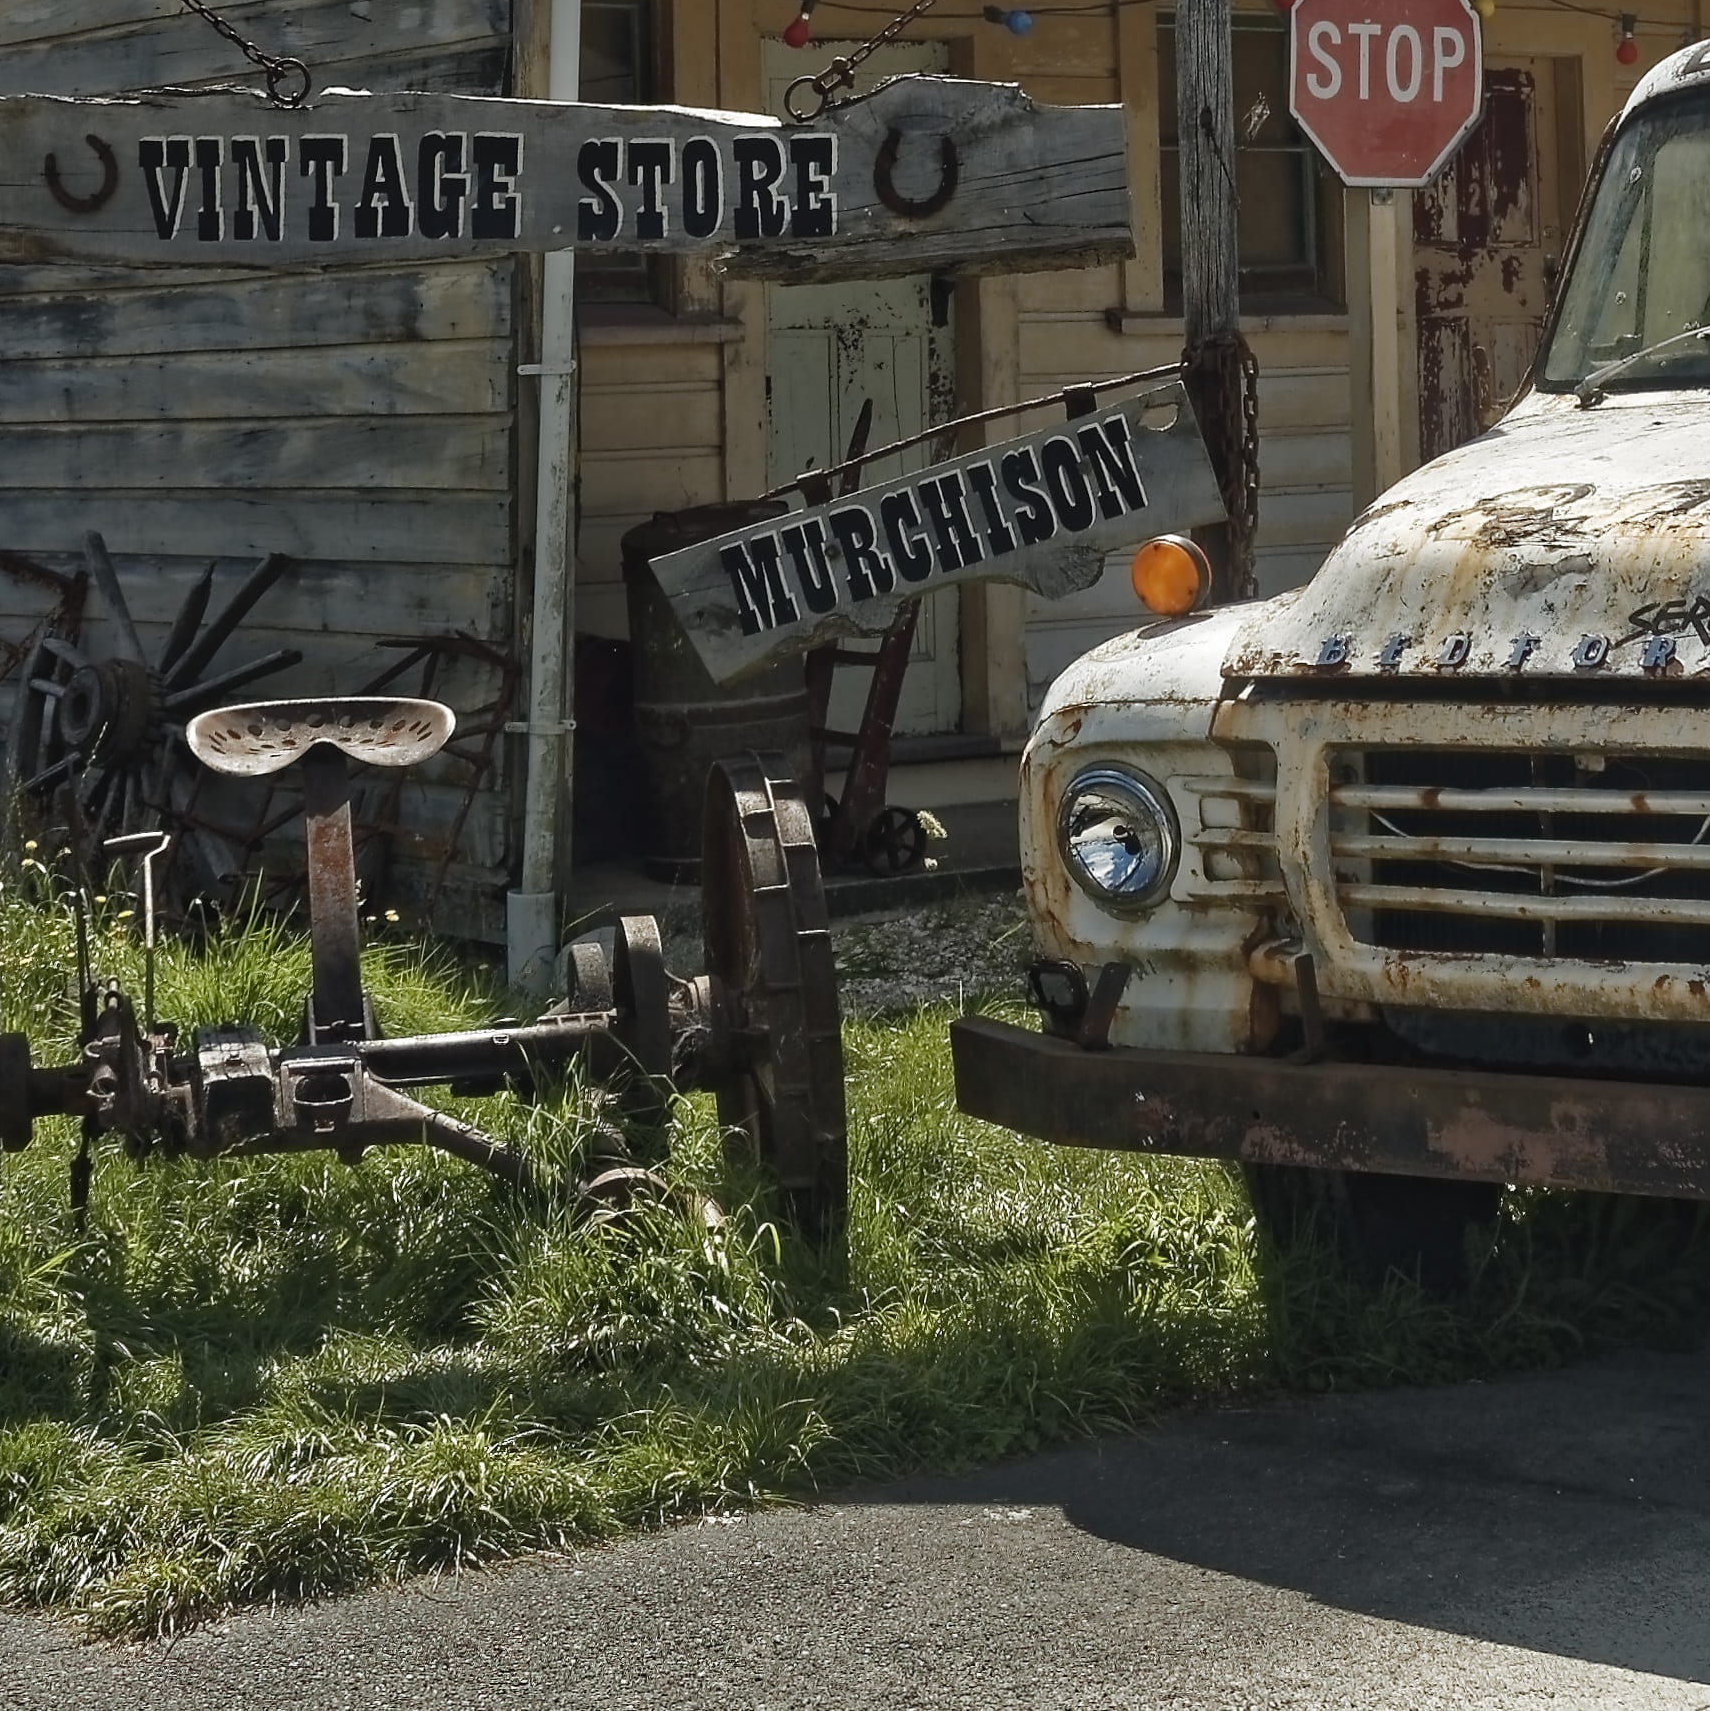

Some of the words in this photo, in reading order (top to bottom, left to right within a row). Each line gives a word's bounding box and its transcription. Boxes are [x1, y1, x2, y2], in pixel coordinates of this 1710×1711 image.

[1306, 20, 1466, 103] STOP
[137, 130, 525, 242] VINTAGE
[576, 131, 840, 242] STORE
[719, 414, 1149, 637] MURCHISON
